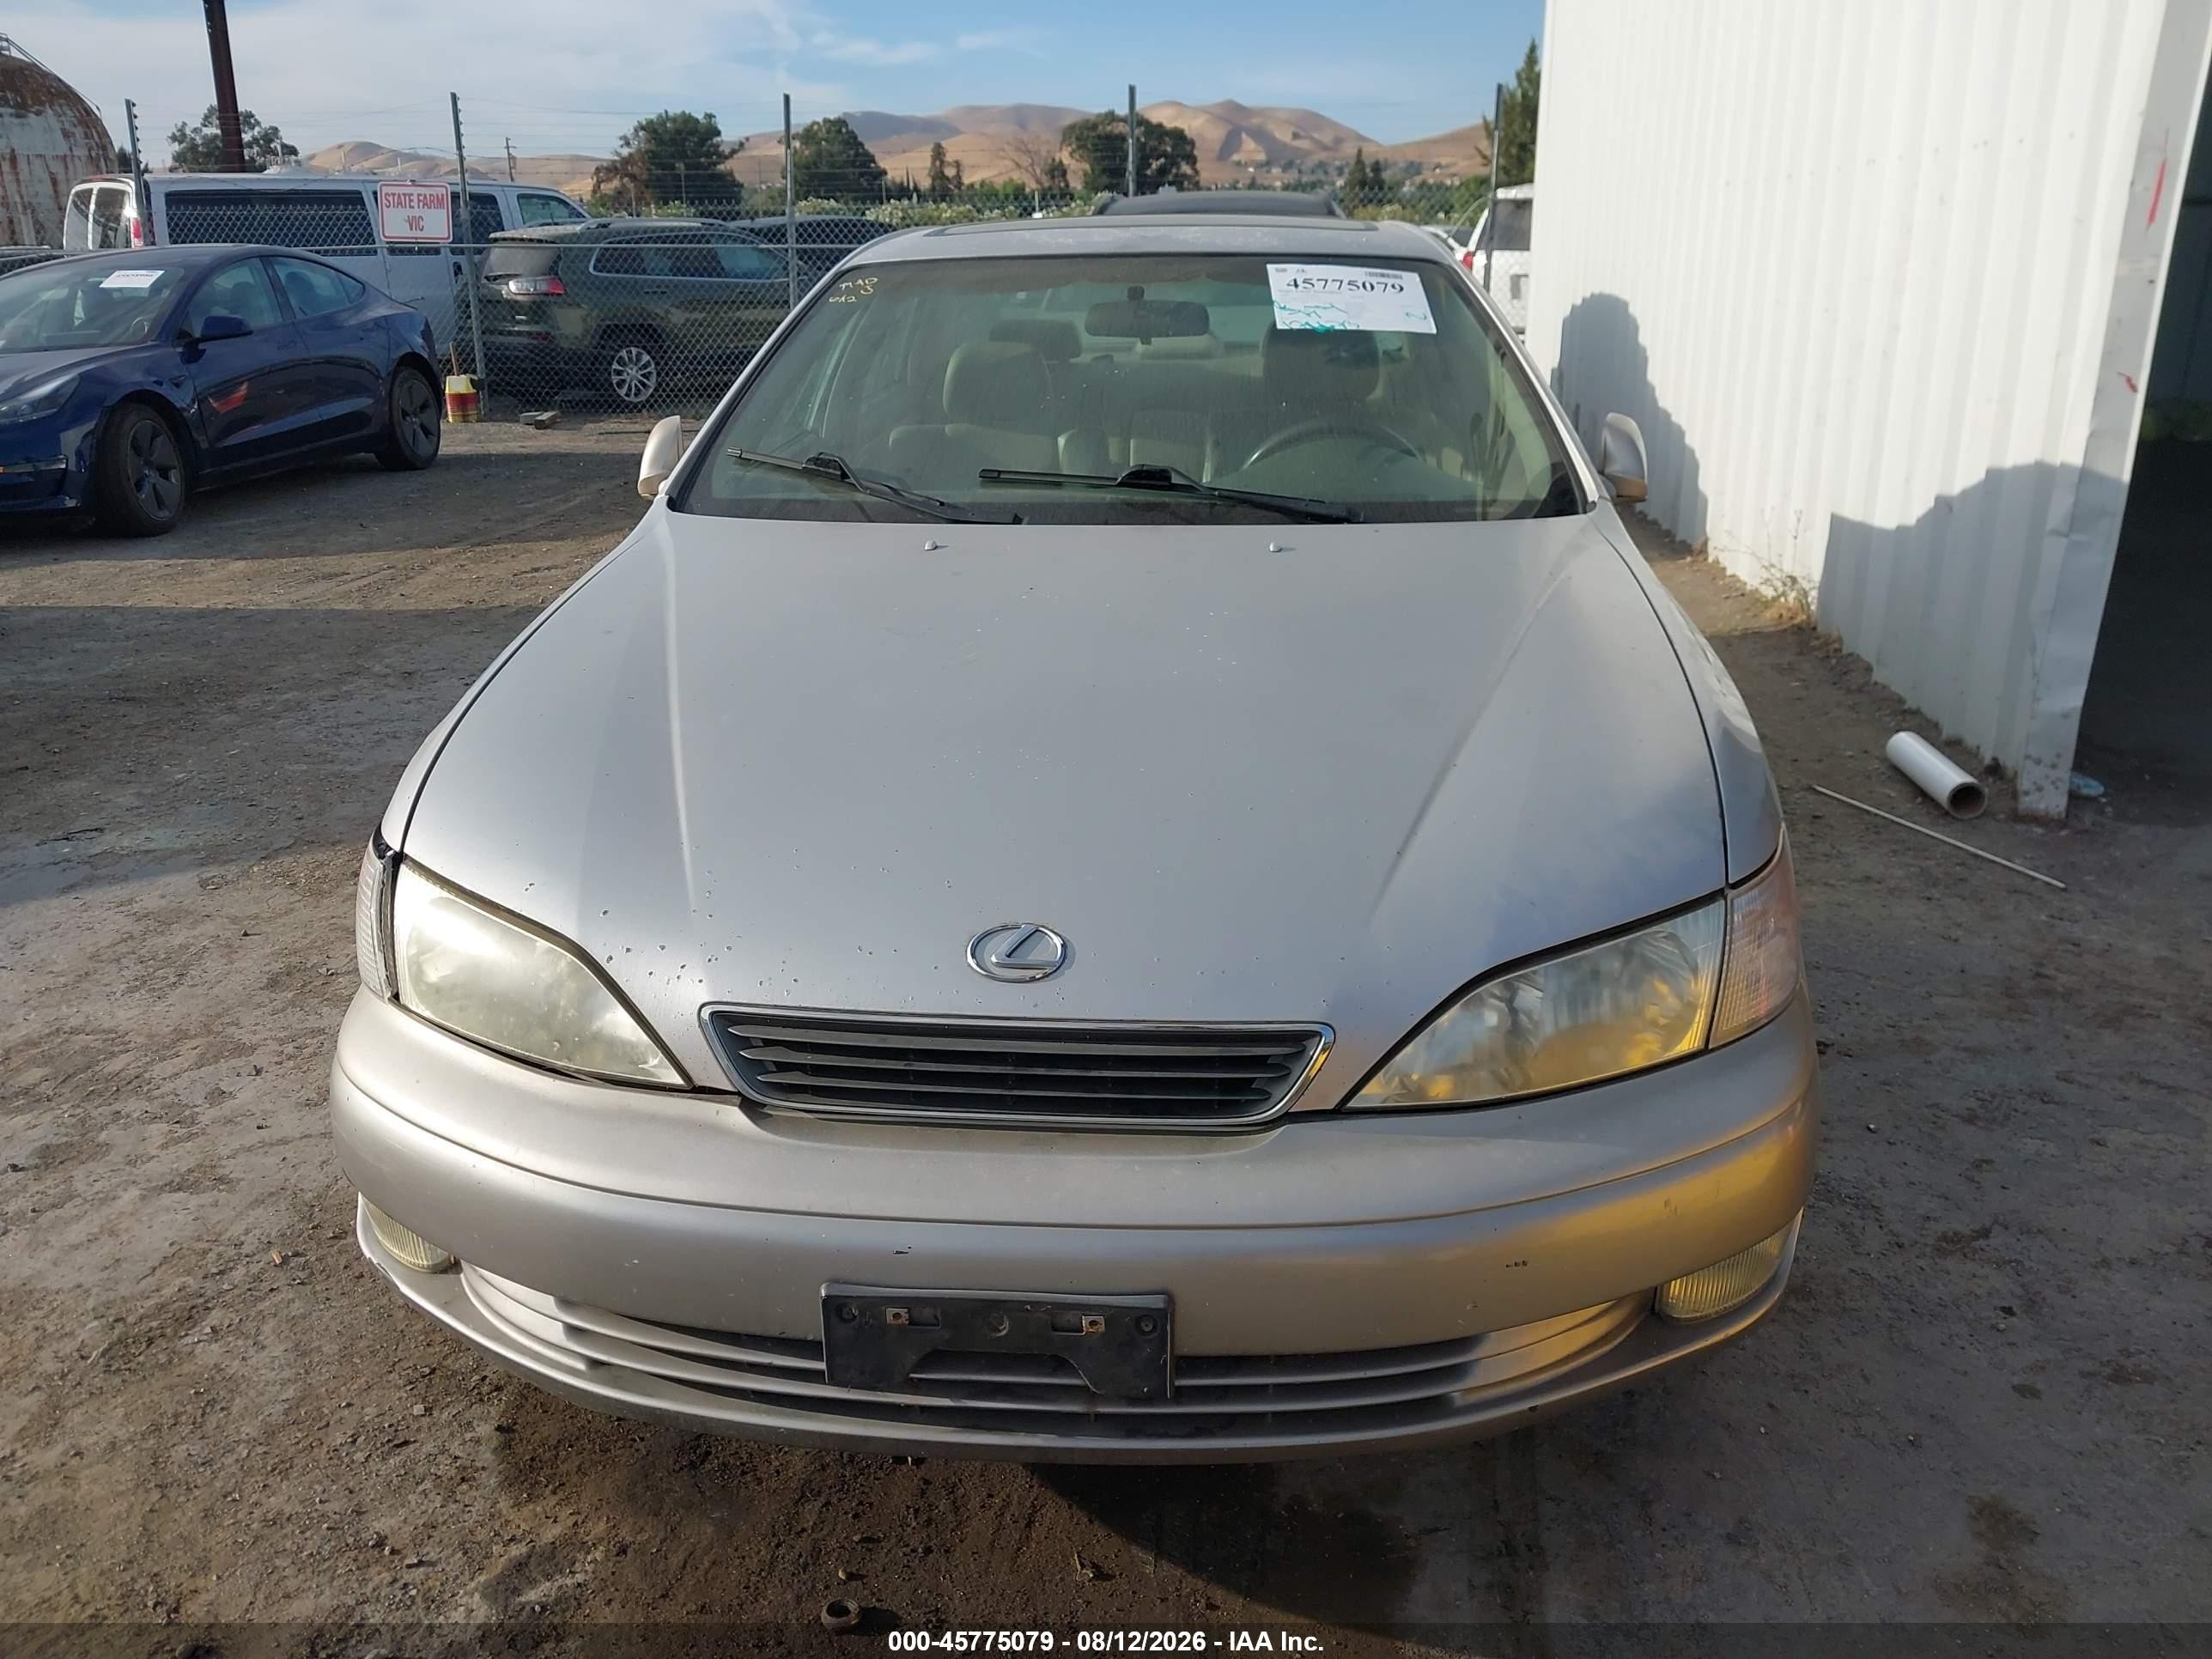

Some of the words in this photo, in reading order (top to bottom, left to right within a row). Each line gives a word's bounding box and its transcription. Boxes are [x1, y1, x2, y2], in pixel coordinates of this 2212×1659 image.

[385, 191, 415, 209] STATE
[416, 192, 446, 210] FARM
[407, 215, 424, 232] VIC
[1286, 277, 1405, 294] 45775079
